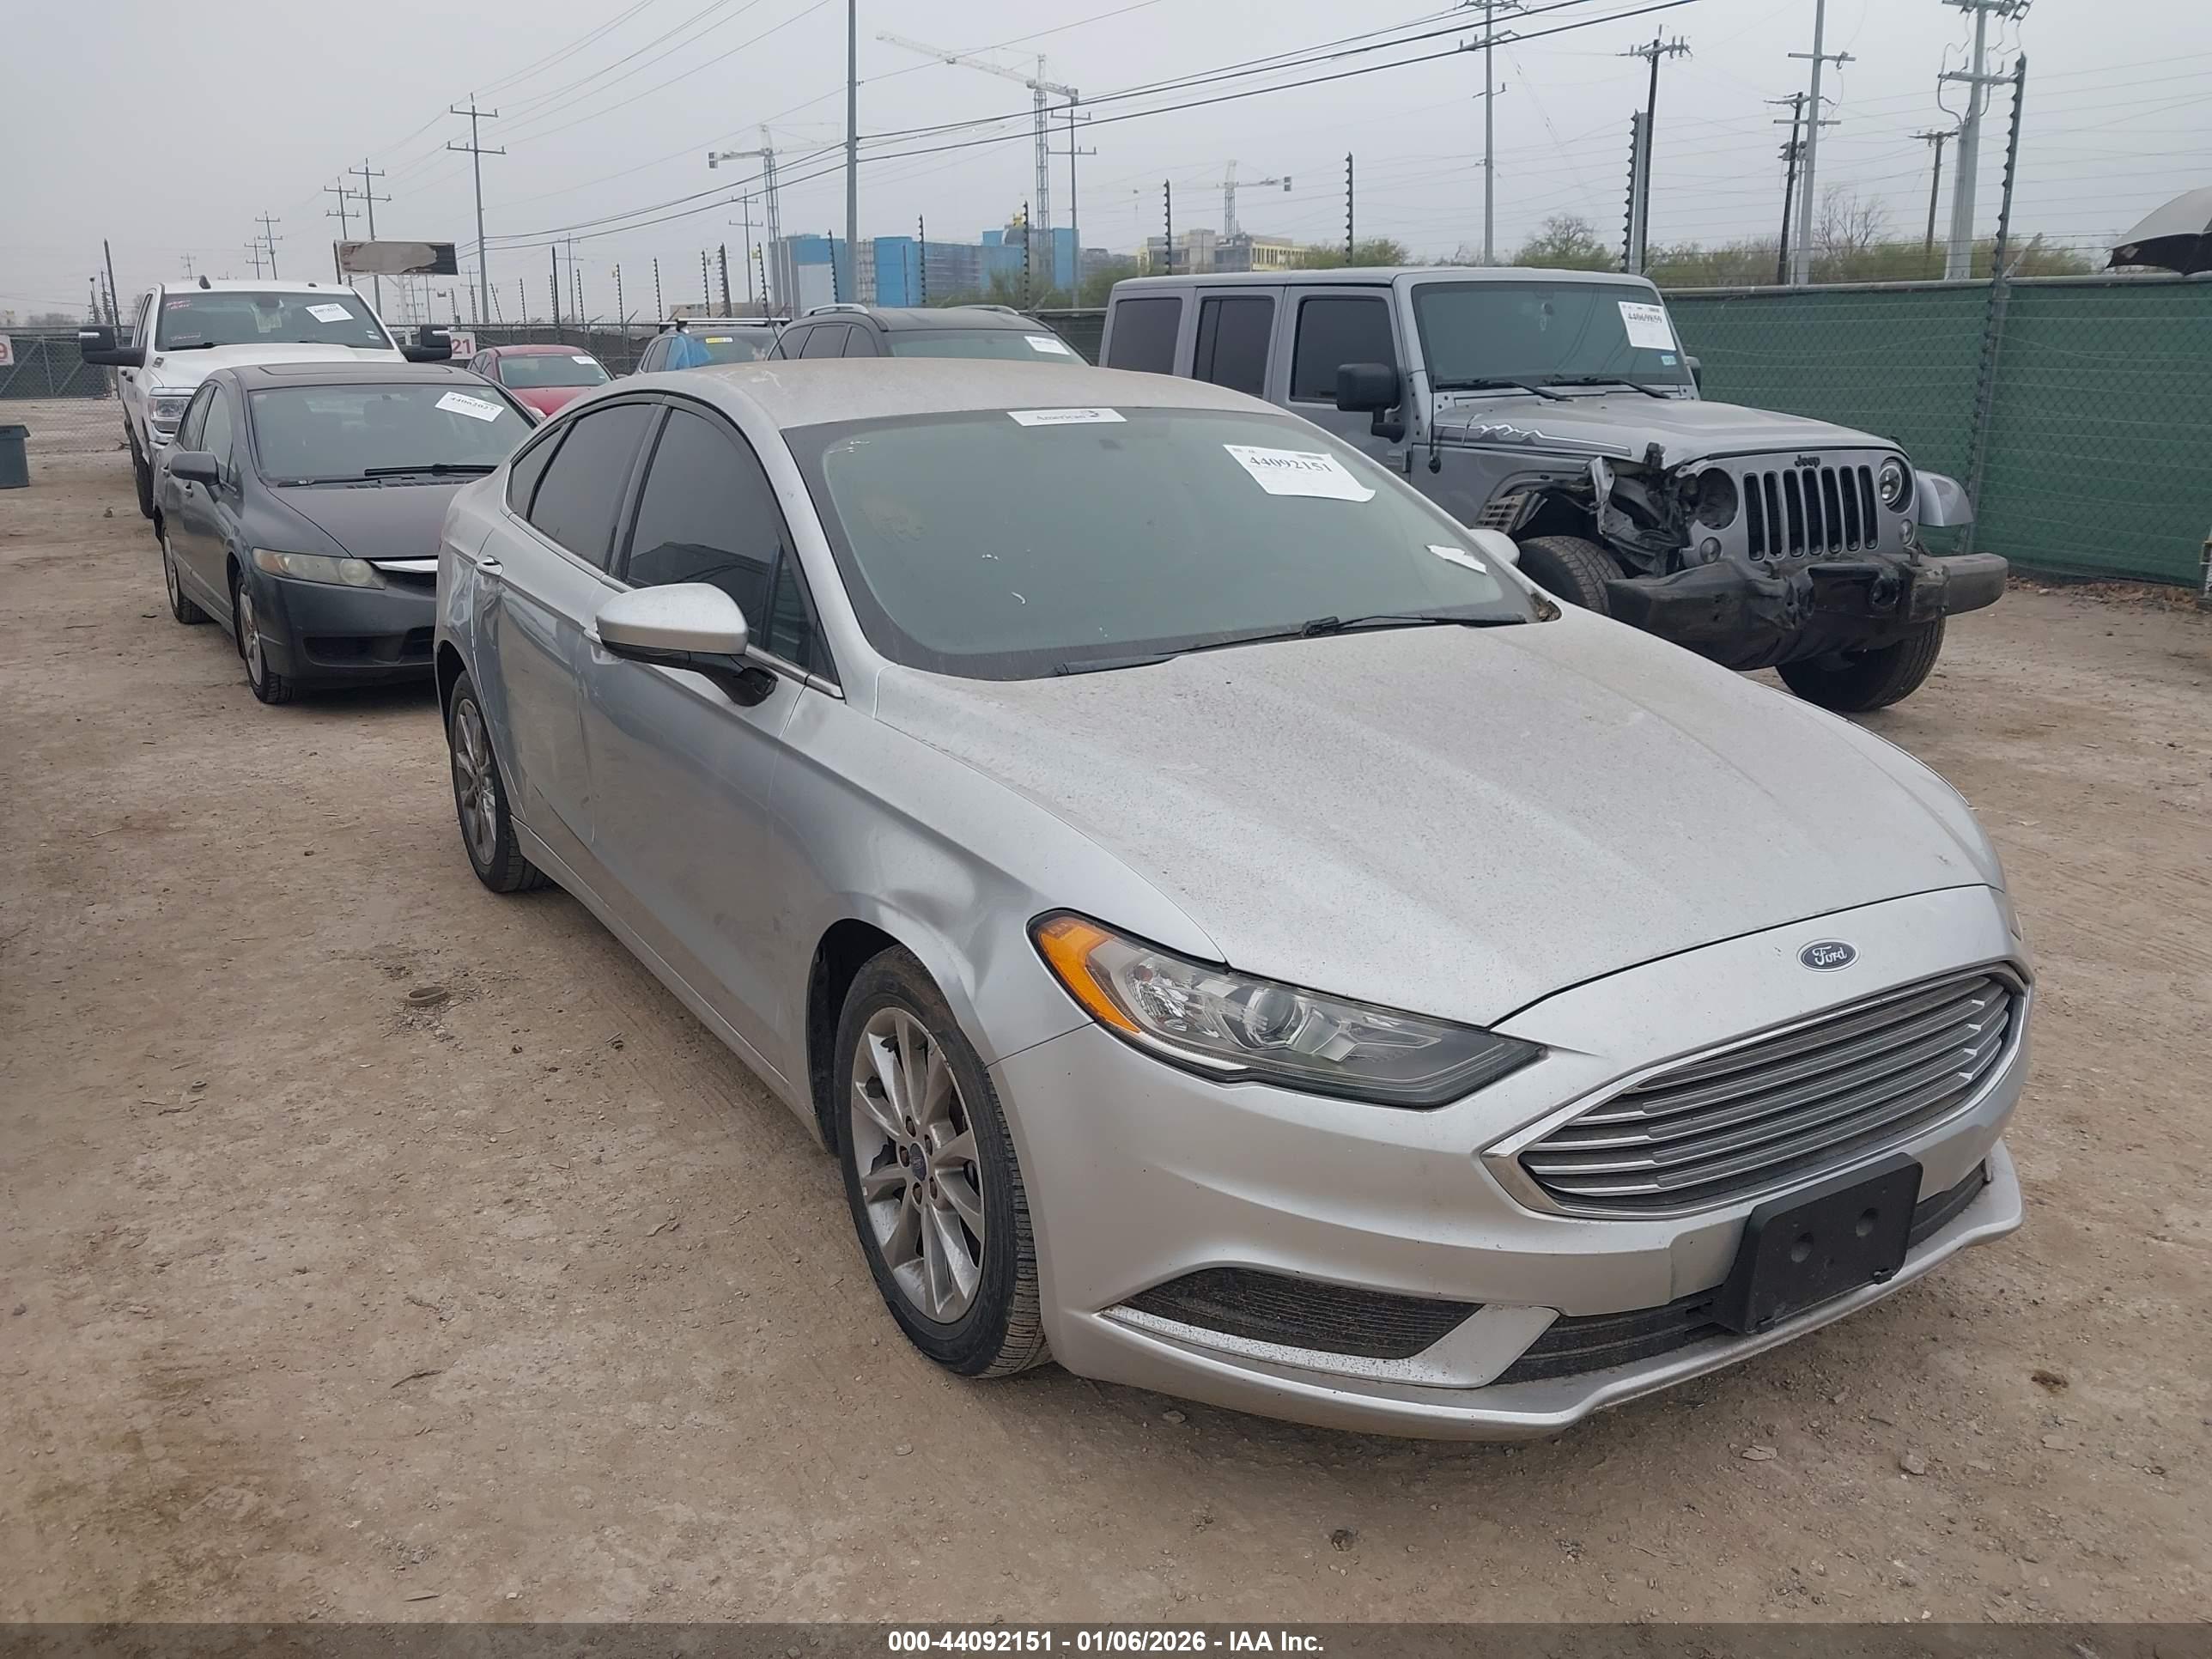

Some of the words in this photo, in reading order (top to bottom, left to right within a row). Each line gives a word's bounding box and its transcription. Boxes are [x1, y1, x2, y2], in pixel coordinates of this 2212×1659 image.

[452, 338, 471, 355] 21
[1249, 456, 1334, 472] 44092151
[1794, 454, 1821, 469] Jeep
[1812, 945, 1848, 966] Ford
